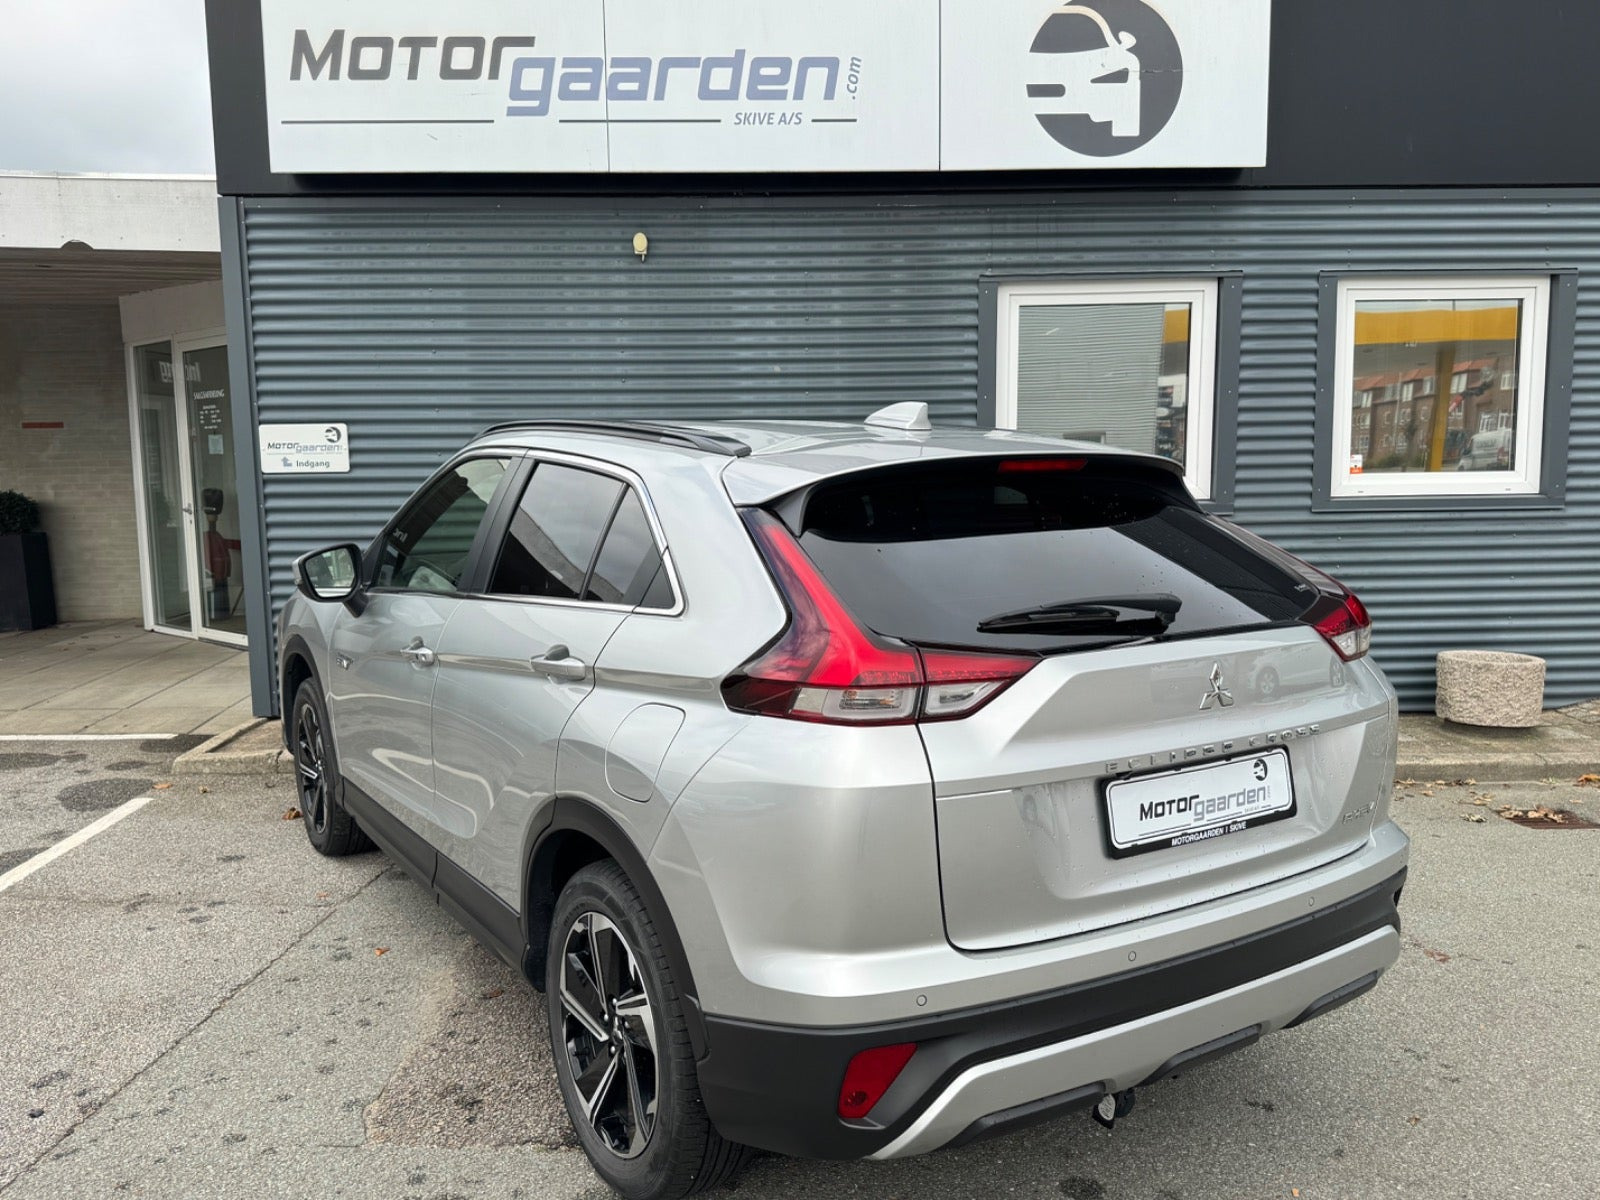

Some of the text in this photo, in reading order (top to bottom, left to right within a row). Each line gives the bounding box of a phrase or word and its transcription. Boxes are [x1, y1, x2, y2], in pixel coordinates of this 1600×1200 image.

[733, 111, 803, 126] SKIVE A/S
[296, 460, 330, 468] Indgang
[1105, 724, 1321, 773] ECLIPSE CROSS
[1171, 827, 1224, 847] MOTORGAARDEN
